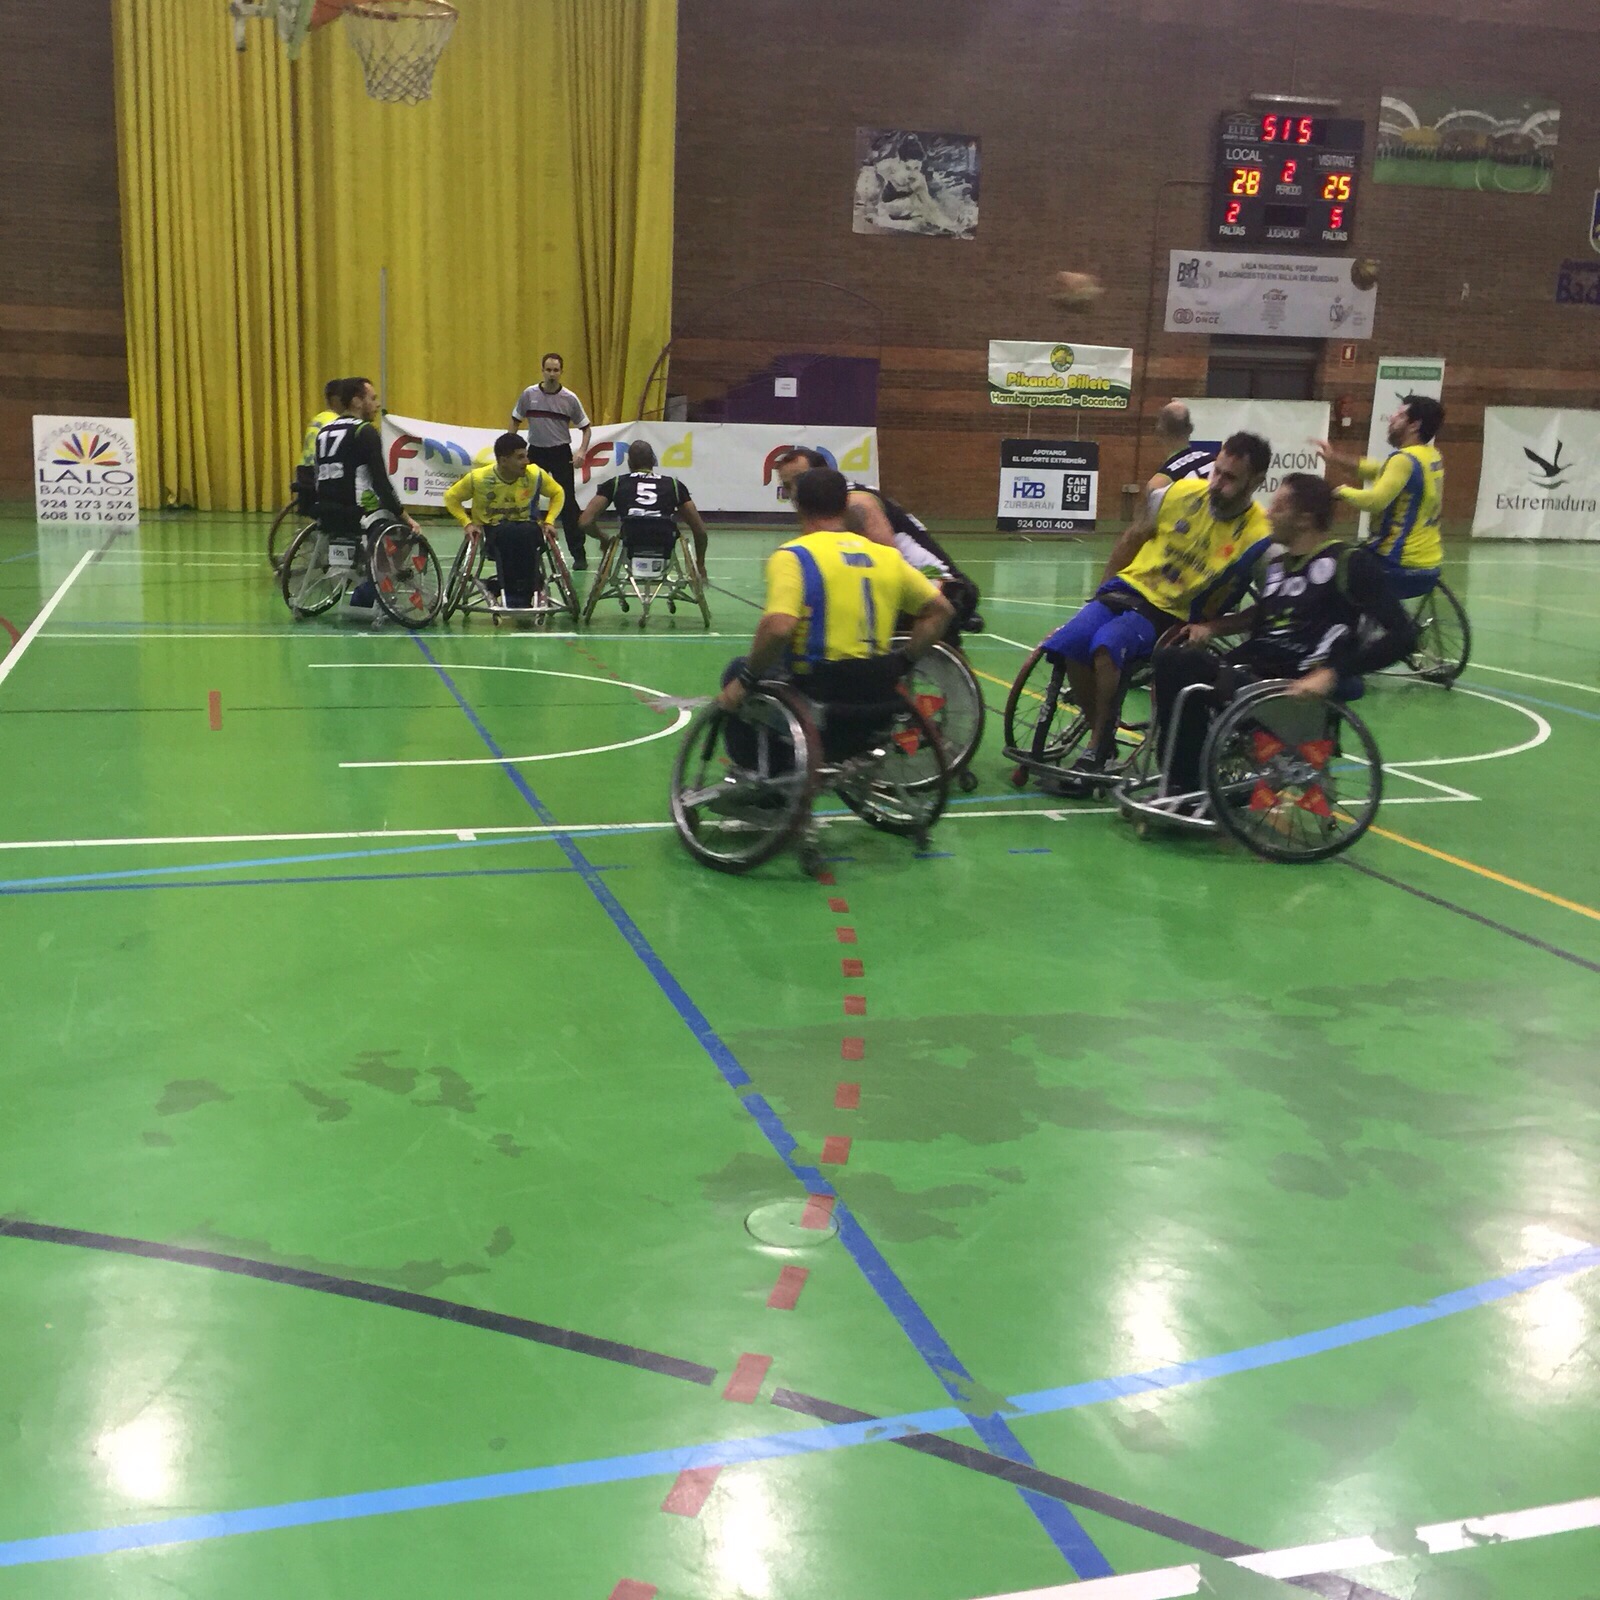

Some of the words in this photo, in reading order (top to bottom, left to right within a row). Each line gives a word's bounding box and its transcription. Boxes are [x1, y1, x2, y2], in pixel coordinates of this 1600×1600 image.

[1228, 125, 1256, 136] ELITE
[1226, 148, 1262, 161] LOCAL
[1318, 154, 1355, 168] VISITANTE
[1281, 160, 1297, 183] 2
[1231, 168, 1261, 195] 28
[1323, 174, 1351, 200] 25
[1226, 201, 1241, 224] 2
[1329, 207, 1343, 230] 5
[1219, 225, 1246, 236] FALTAS
[1267, 228, 1300, 239] JUGADOR
[1322, 230, 1348, 241] FALTAS
[1006, 371, 1065, 389] Pikando
[1067, 374, 1111, 390] Billete
[74, 421, 136, 465] DECORATIVAS
[318, 429, 347, 458] 17
[1020, 456, 1049, 464] DEPORTE
[1049, 456, 1087, 465] EXTREMEÑO
[39, 468, 134, 485] LALO
[1067, 477, 1087, 486] CAN
[40, 485, 135, 497] BADAJOZ
[635, 482, 658, 505] 5
[1013, 481, 1045, 499] HZB
[1066, 485, 1086, 494] TUE
[40, 500, 68, 509] 924
[75, 500, 102, 510] 273
[106, 501, 133, 510] 574
[1496, 493, 1597, 513] Extremadura
[40, 511, 68, 521] 608
[117, 513, 136, 522] 07
[1016, 519, 1034, 529] 924
[1035, 520, 1053, 529] 001
[1054, 520, 1074, 529] 400
